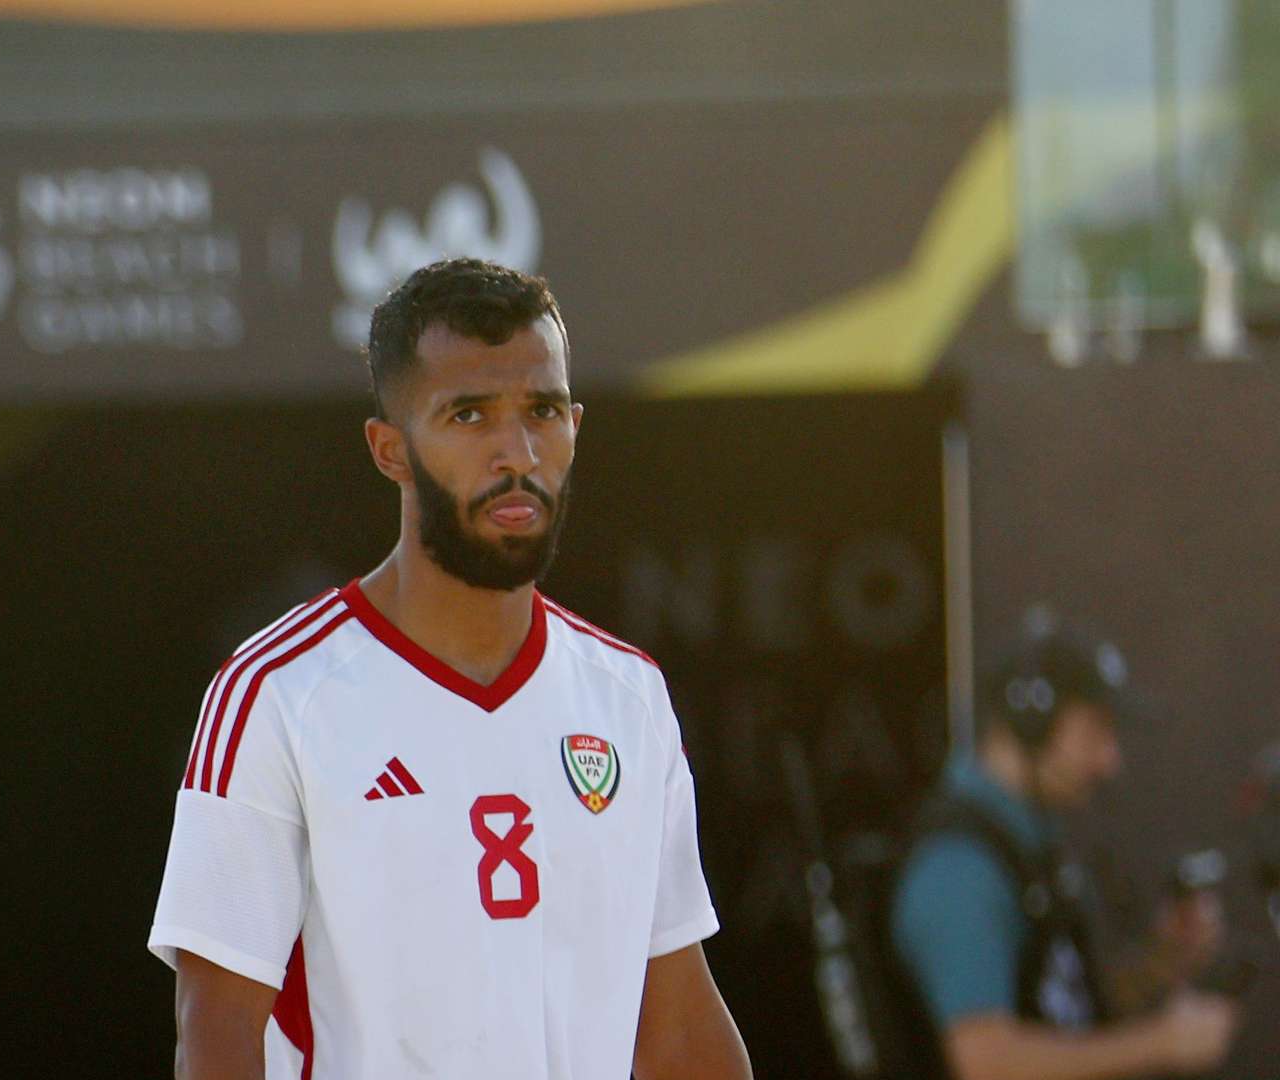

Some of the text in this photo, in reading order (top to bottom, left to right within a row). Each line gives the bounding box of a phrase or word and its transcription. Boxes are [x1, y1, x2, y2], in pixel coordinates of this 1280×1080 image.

[578, 755, 605, 768] UAE
[586, 767, 601, 778] FA
[470, 794, 540, 919] 8
